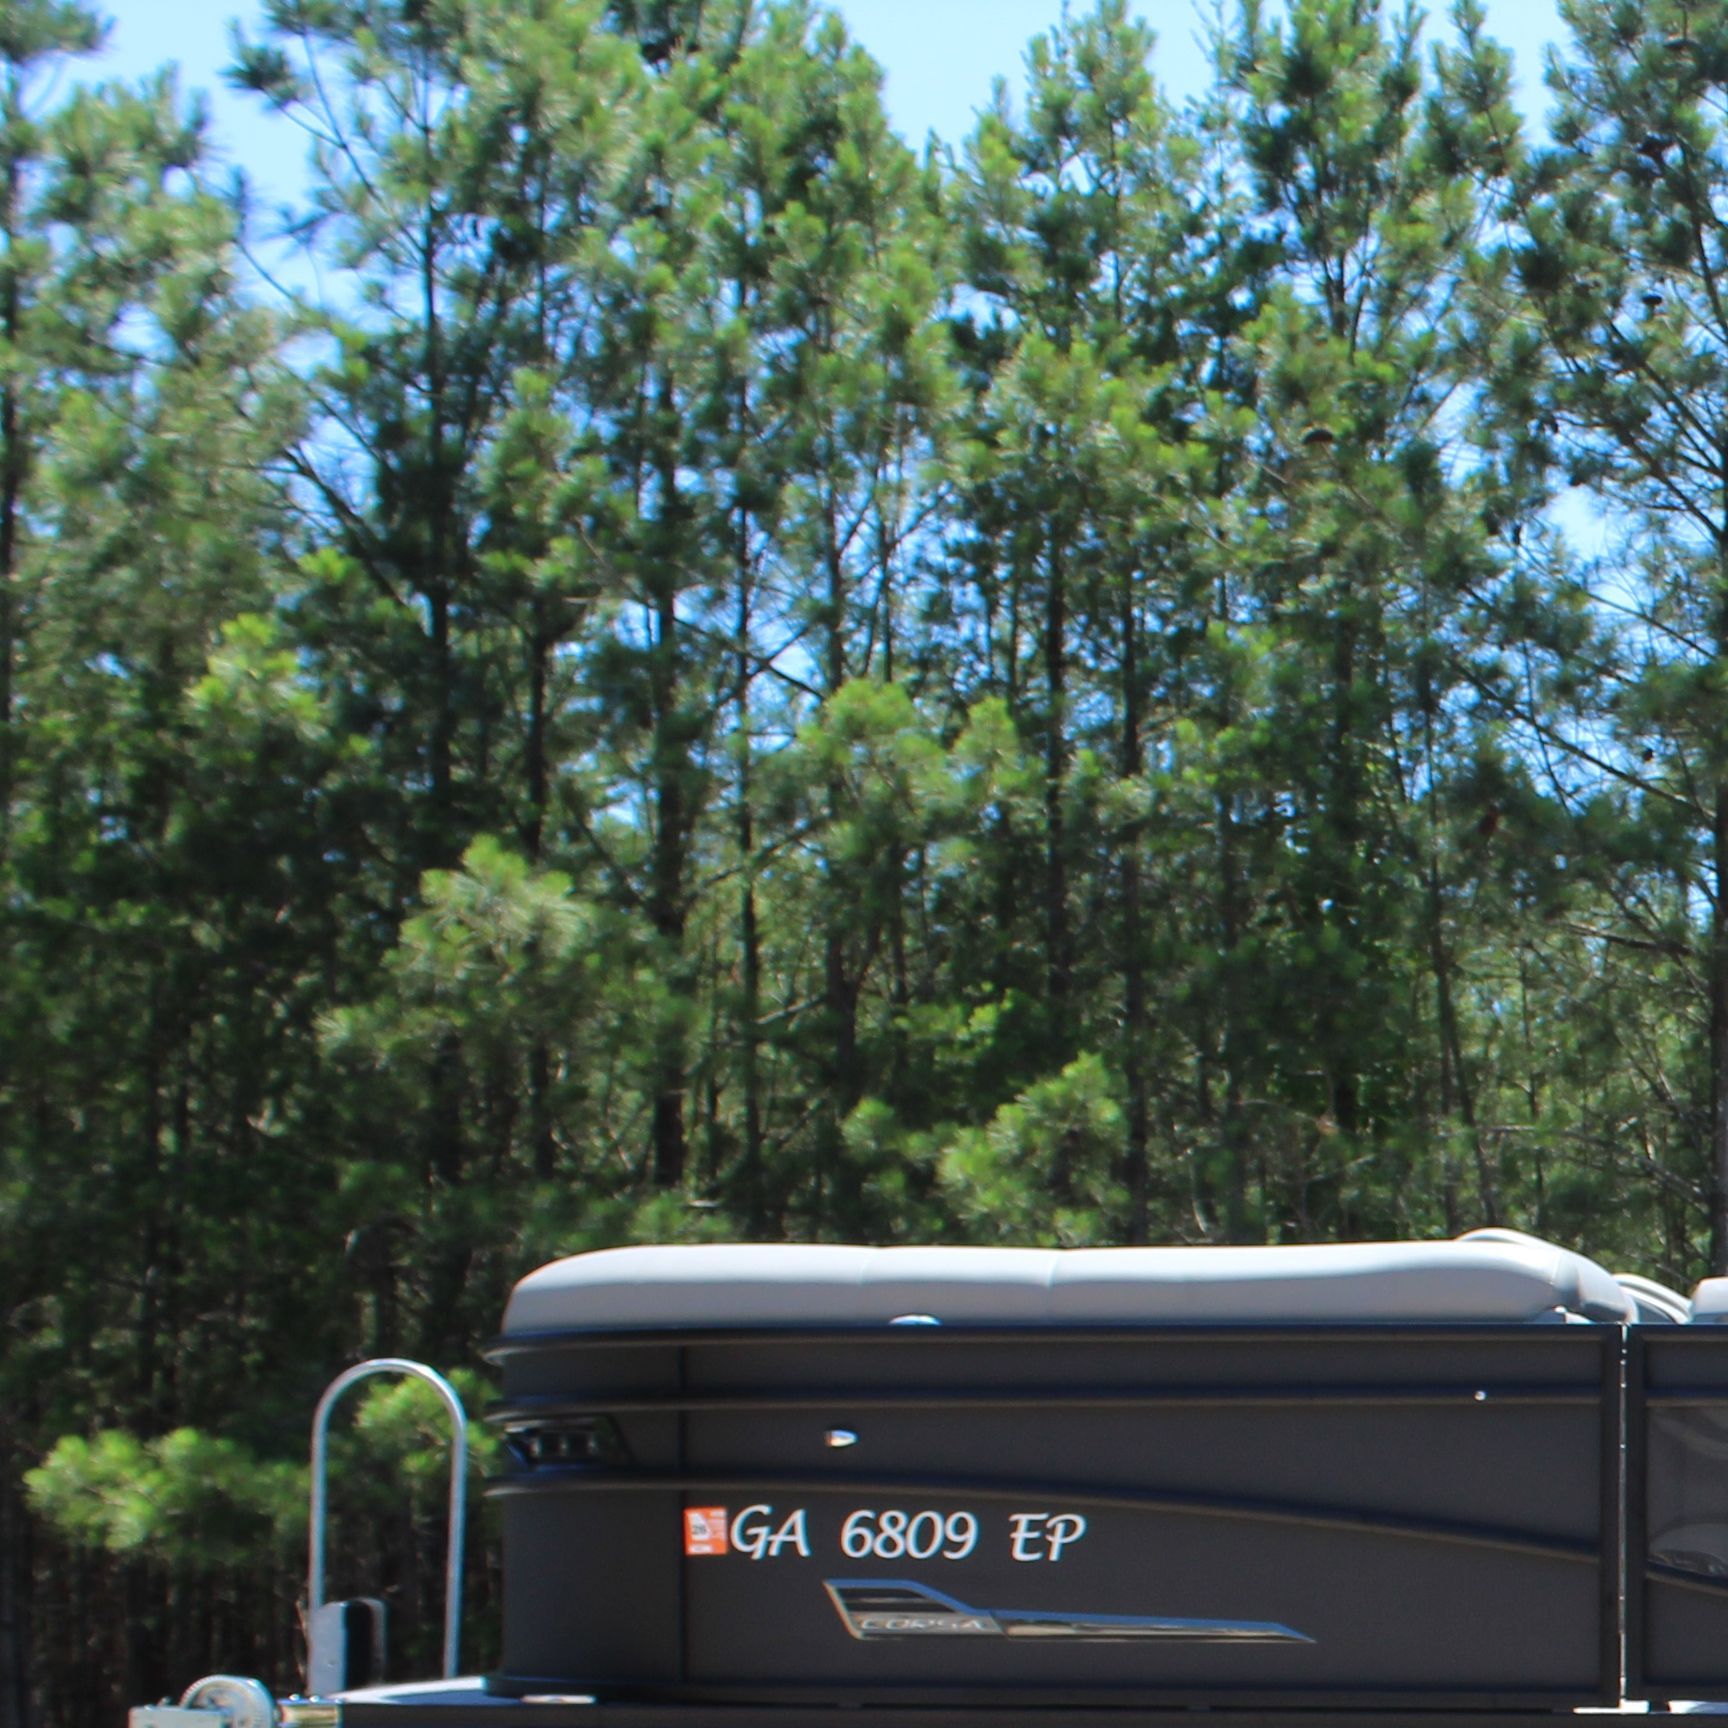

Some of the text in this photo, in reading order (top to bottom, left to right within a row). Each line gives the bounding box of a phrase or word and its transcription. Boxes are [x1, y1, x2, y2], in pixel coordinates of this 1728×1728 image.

[730, 1504, 811, 1560] GA
[840, 1509, 978, 1560] 6809
[1008, 1512, 1086, 1562] EP
